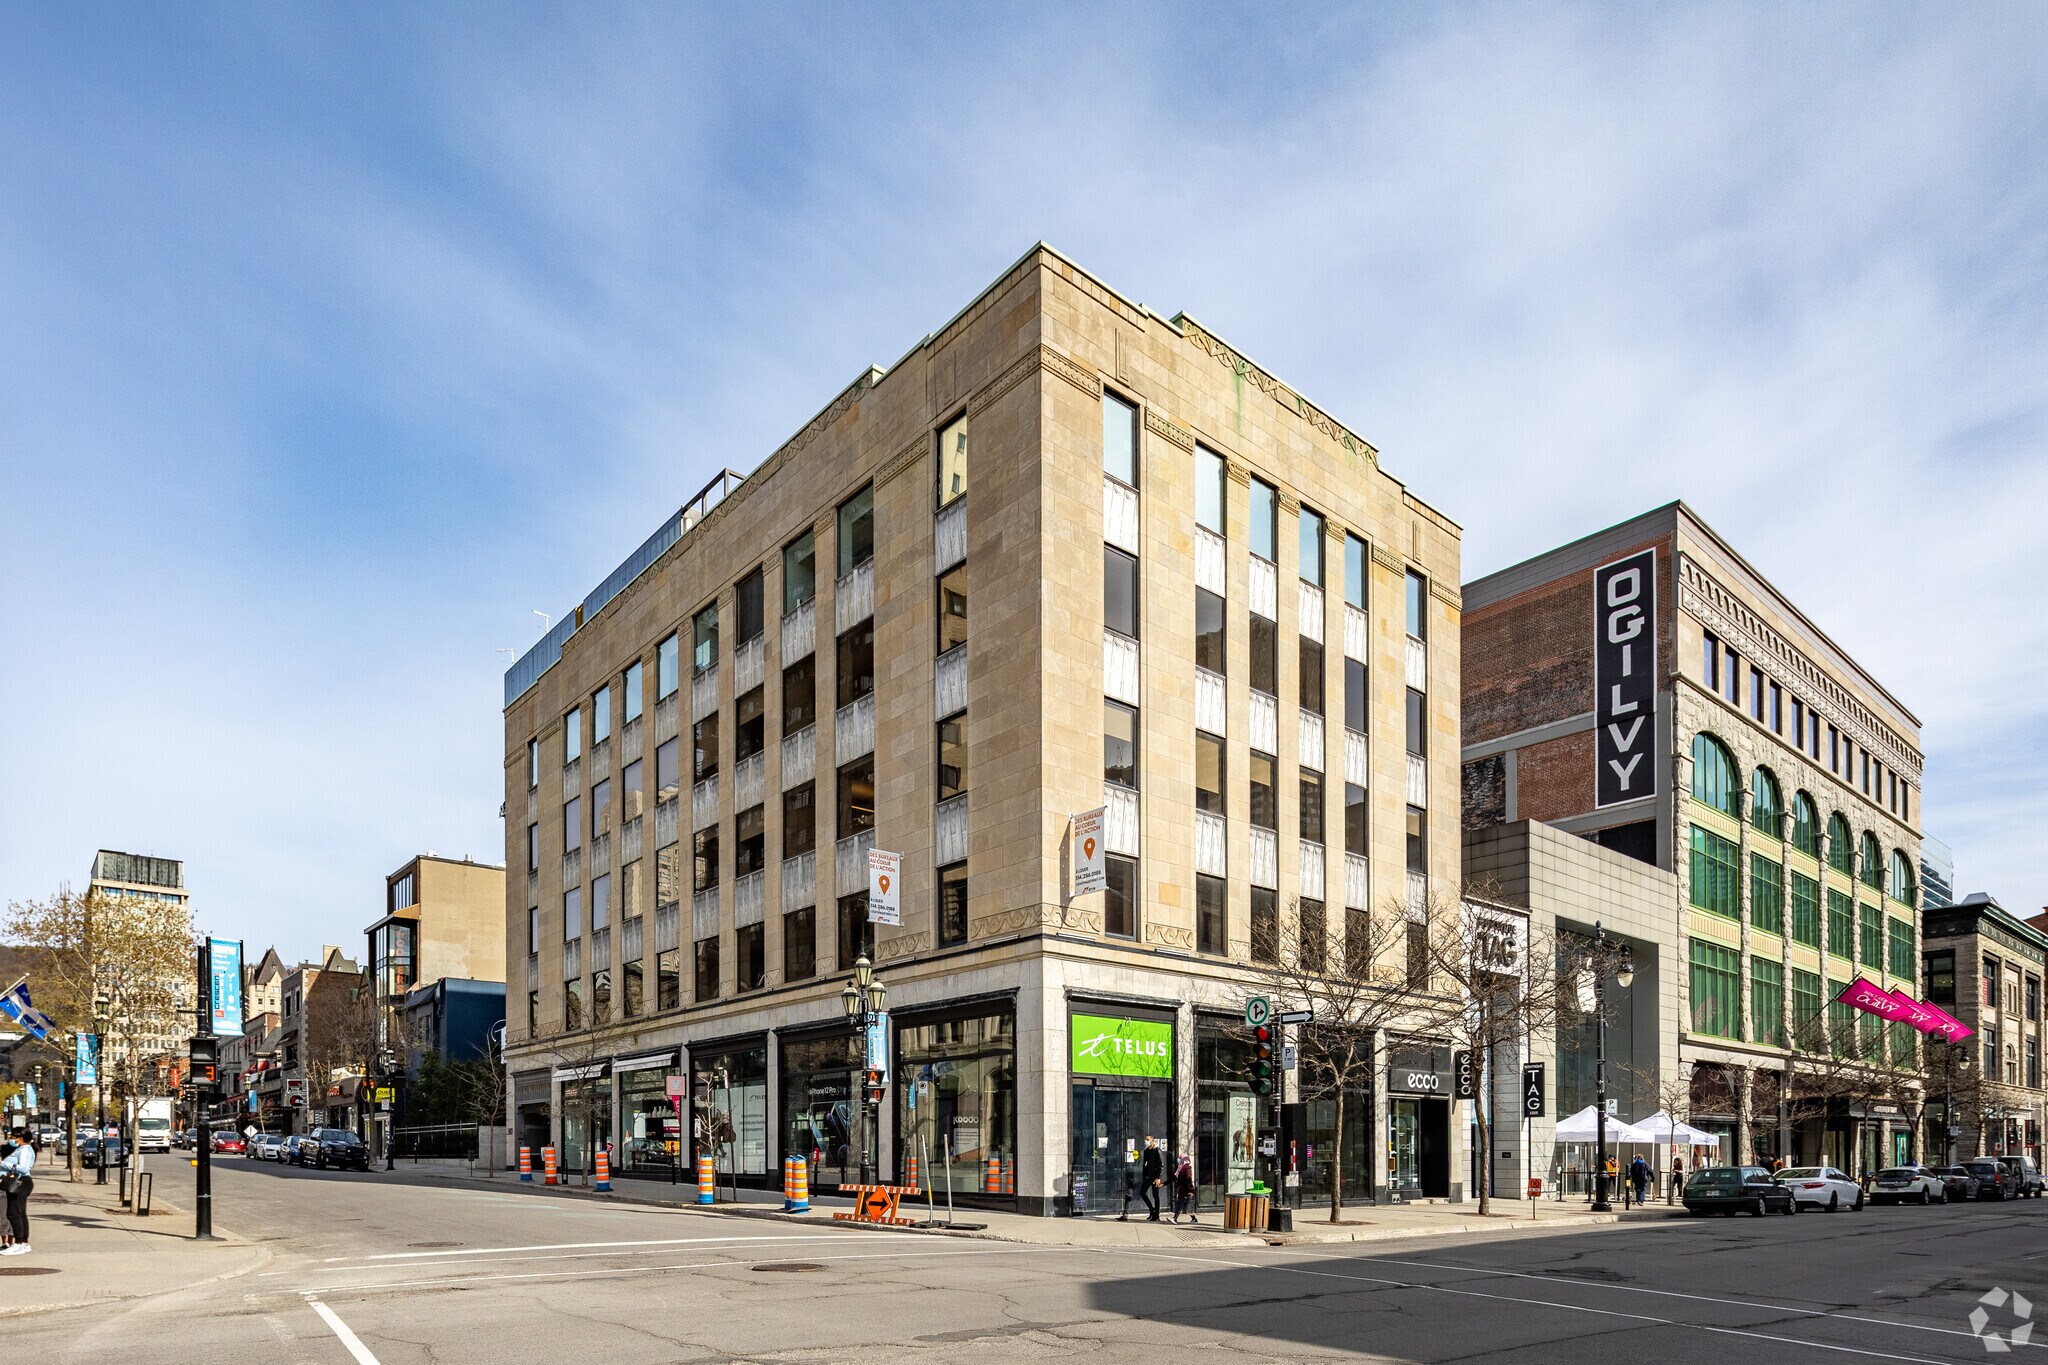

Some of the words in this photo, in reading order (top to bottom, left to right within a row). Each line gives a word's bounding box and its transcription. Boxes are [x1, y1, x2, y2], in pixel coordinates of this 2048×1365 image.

[1607, 567, 1645, 792] OGILVY
[1082, 820, 1097, 829] COEUR
[1113, 1038, 1167, 1057] TELUS
[1407, 1073, 1439, 1090] ecco
[1527, 1069, 1541, 1110] TAG
